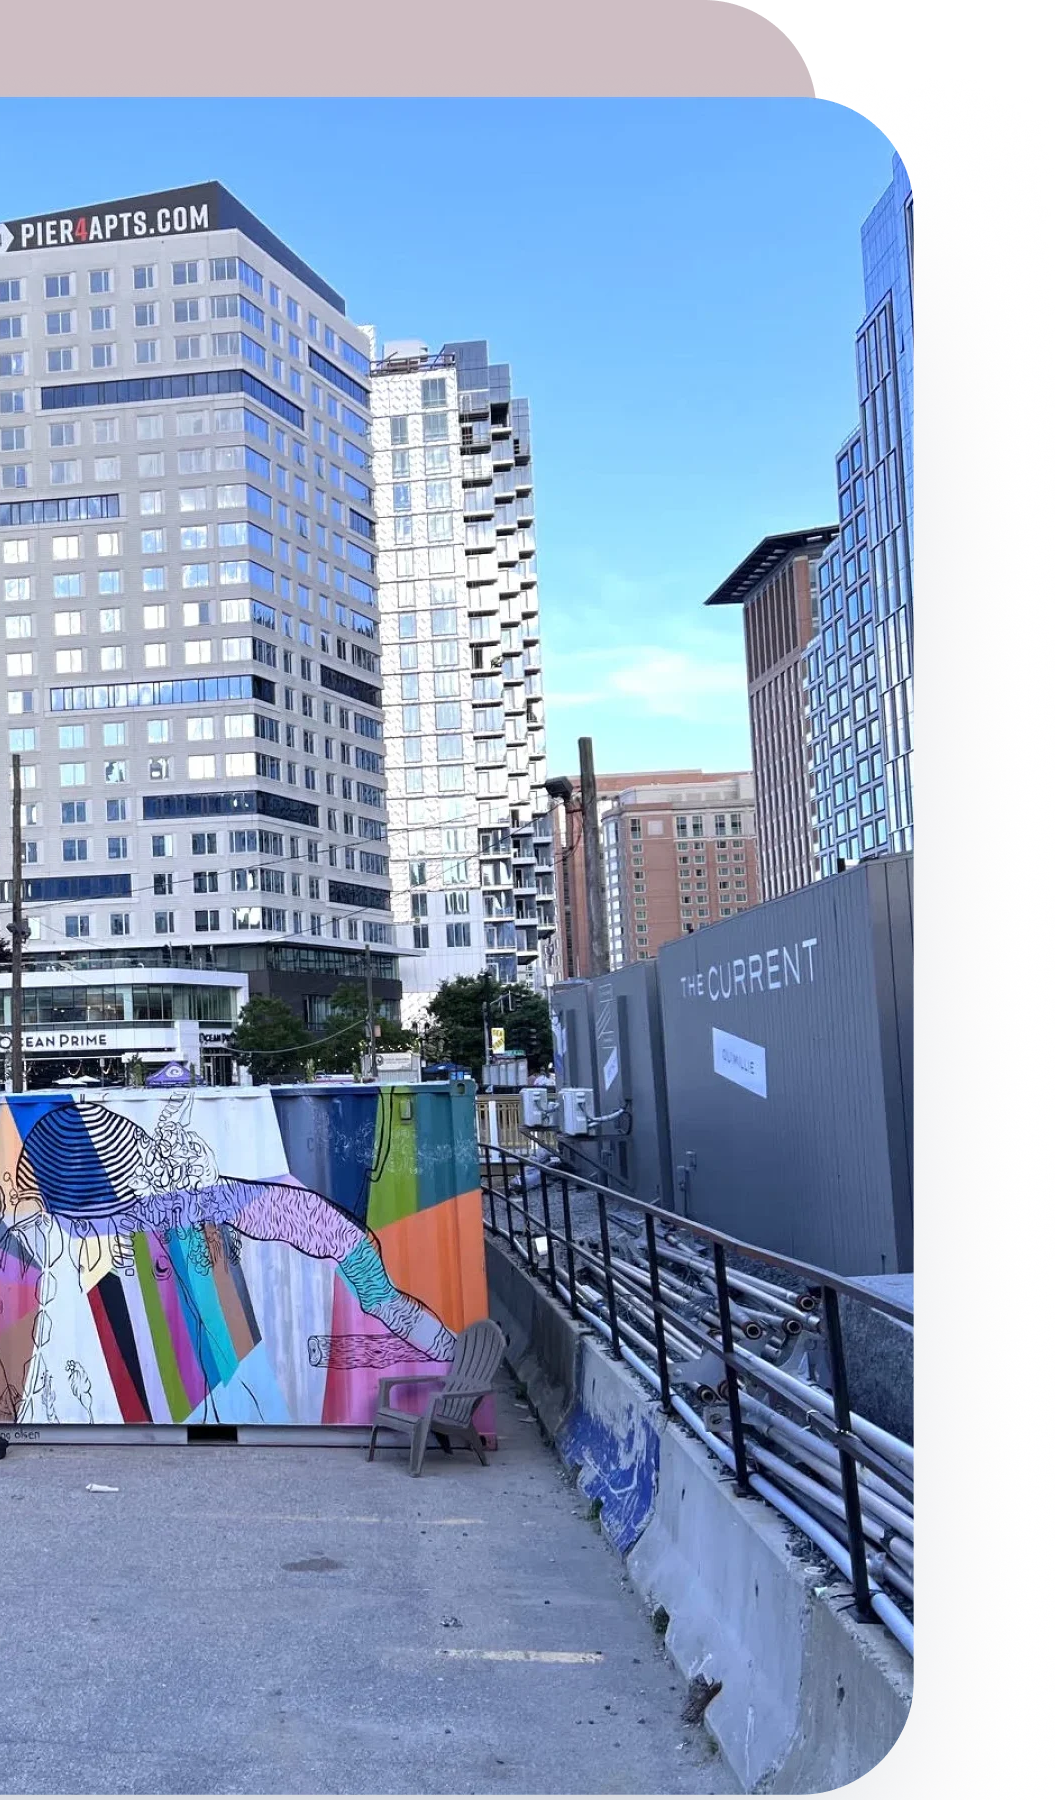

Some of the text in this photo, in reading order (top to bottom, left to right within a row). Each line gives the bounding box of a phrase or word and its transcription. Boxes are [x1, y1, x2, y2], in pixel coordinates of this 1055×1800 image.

[21, 203, 209, 248] PIER4APTS.COM
[680, 937, 817, 1001] THE CURRENT
[59, 1034, 107, 1048] PRIME
